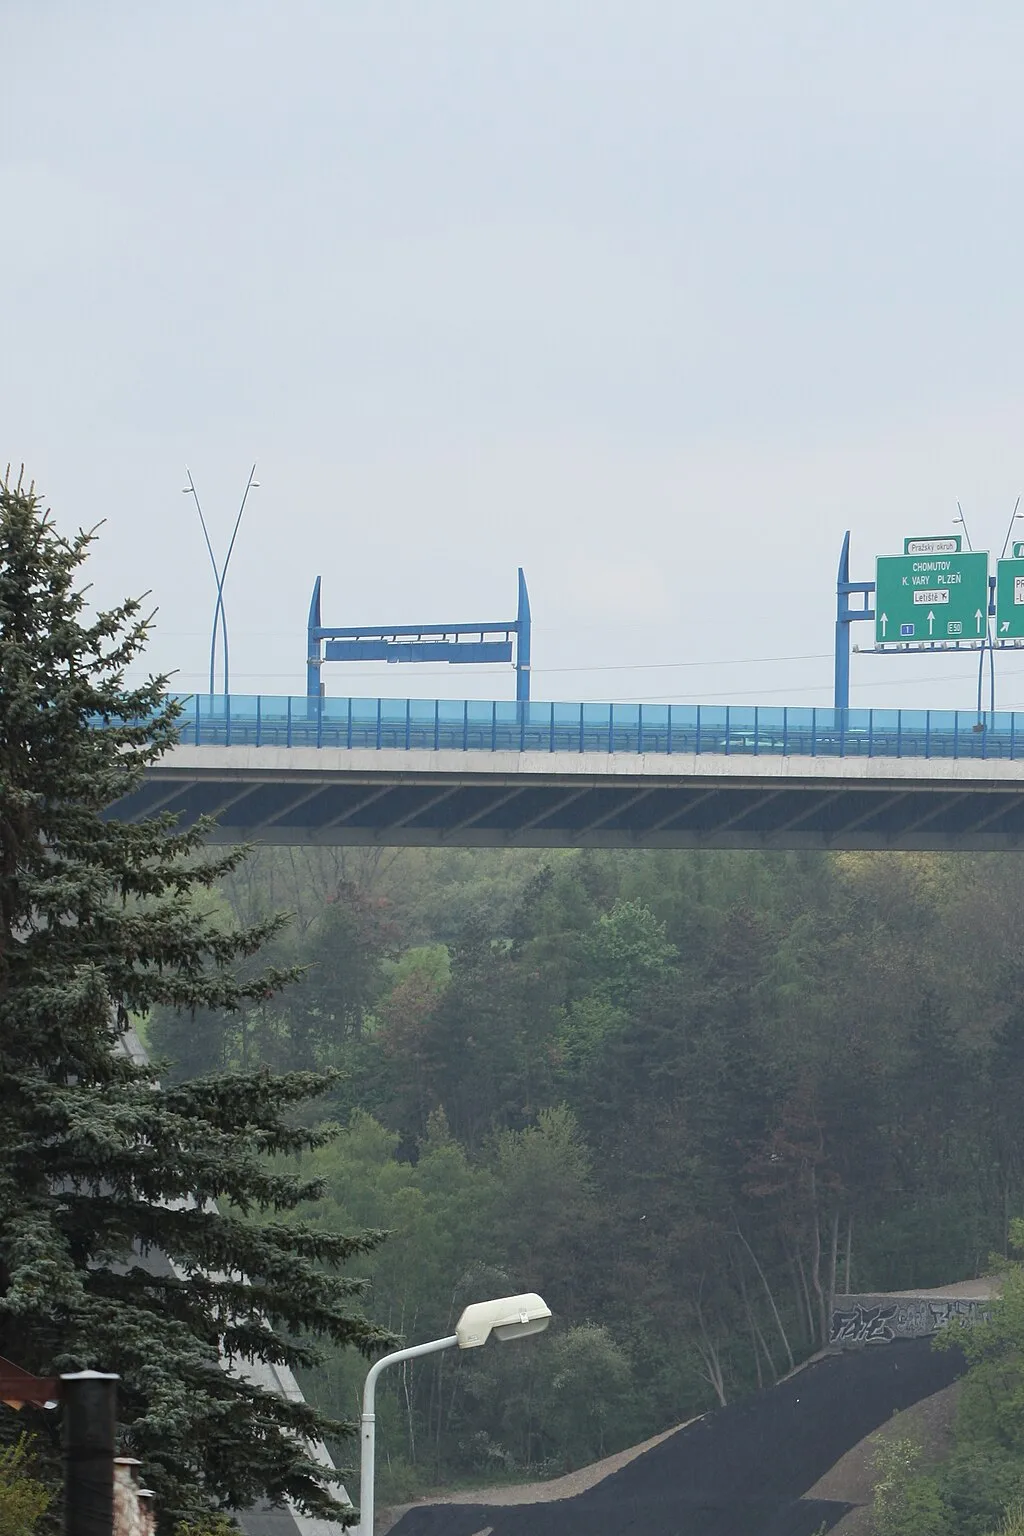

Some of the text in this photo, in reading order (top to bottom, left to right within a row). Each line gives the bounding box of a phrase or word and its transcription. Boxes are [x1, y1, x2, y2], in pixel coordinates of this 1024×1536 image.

[911, 542, 954, 553] Pražský okruh
[912, 561, 951, 572] CHOMUTOV
[902, 571, 962, 586] K. VARY PLZEŇ
[915, 592, 939, 602] Letiště
[953, 623, 961, 632] 50
